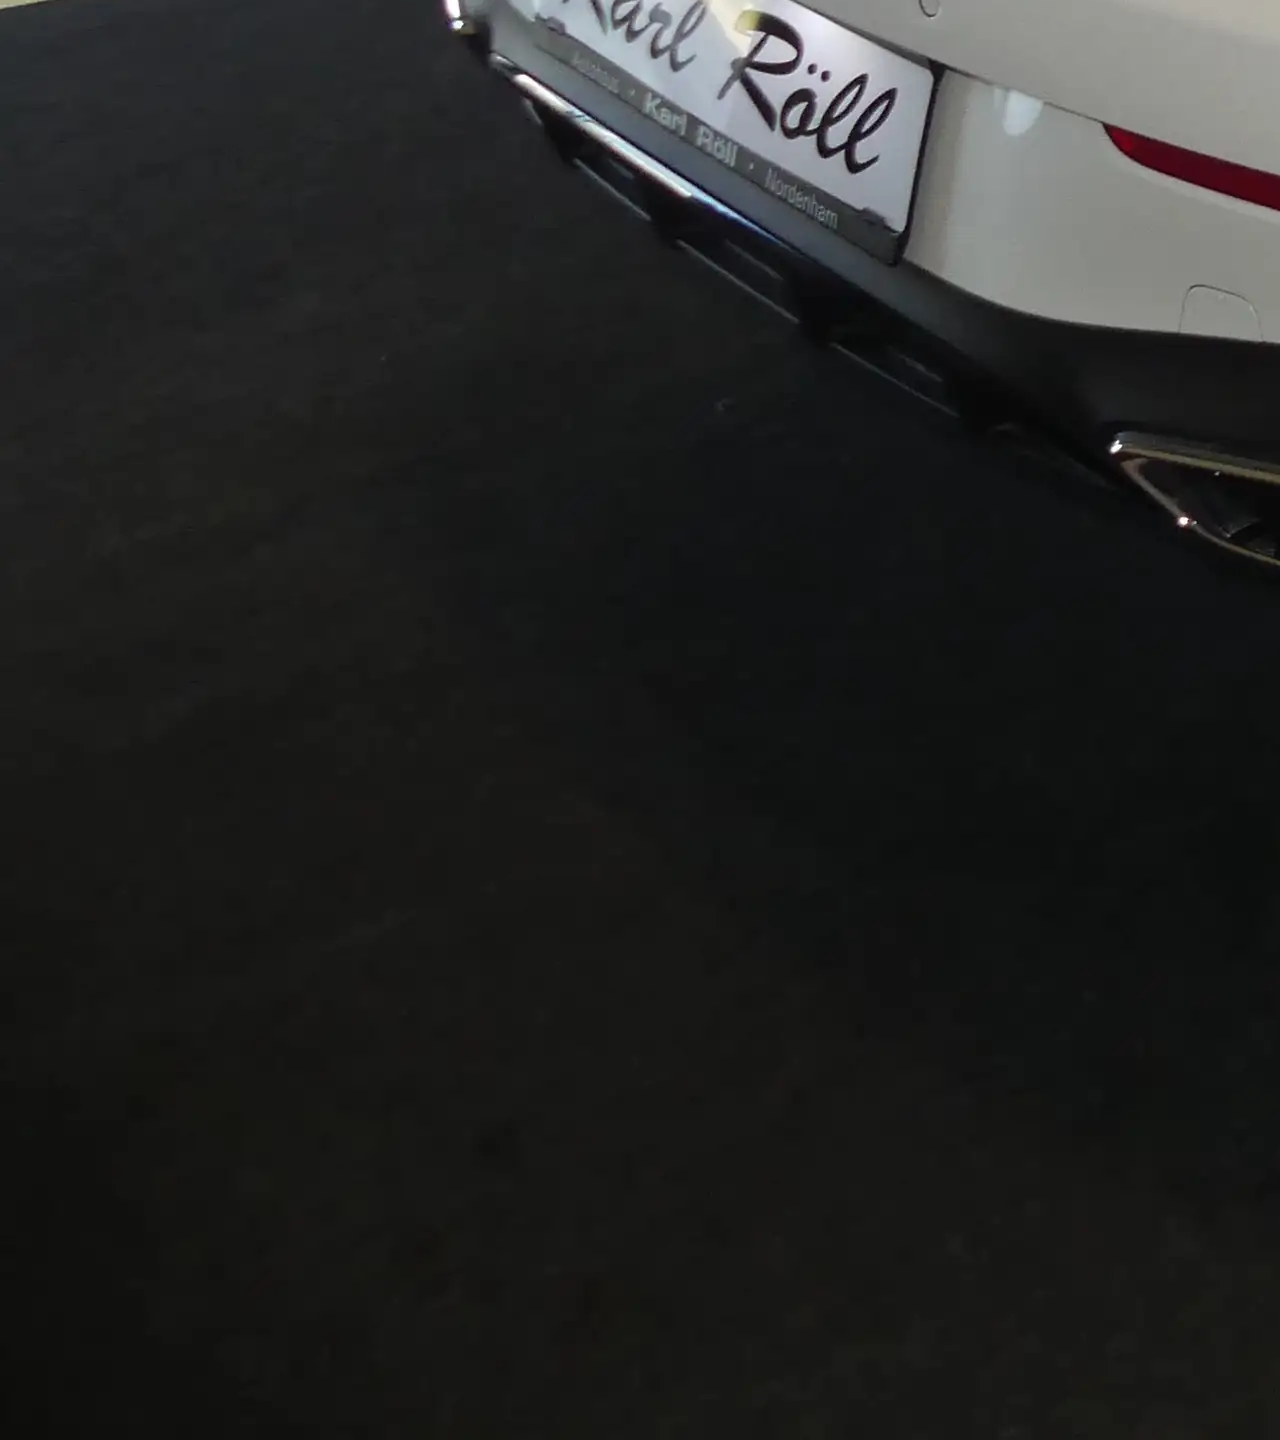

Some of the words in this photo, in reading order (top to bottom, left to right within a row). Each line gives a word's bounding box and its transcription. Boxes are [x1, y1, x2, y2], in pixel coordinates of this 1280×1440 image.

[643, 91, 688, 137] Karl
[764, 167, 839, 231] Nordenham
[717, 9, 898, 175] Röll
